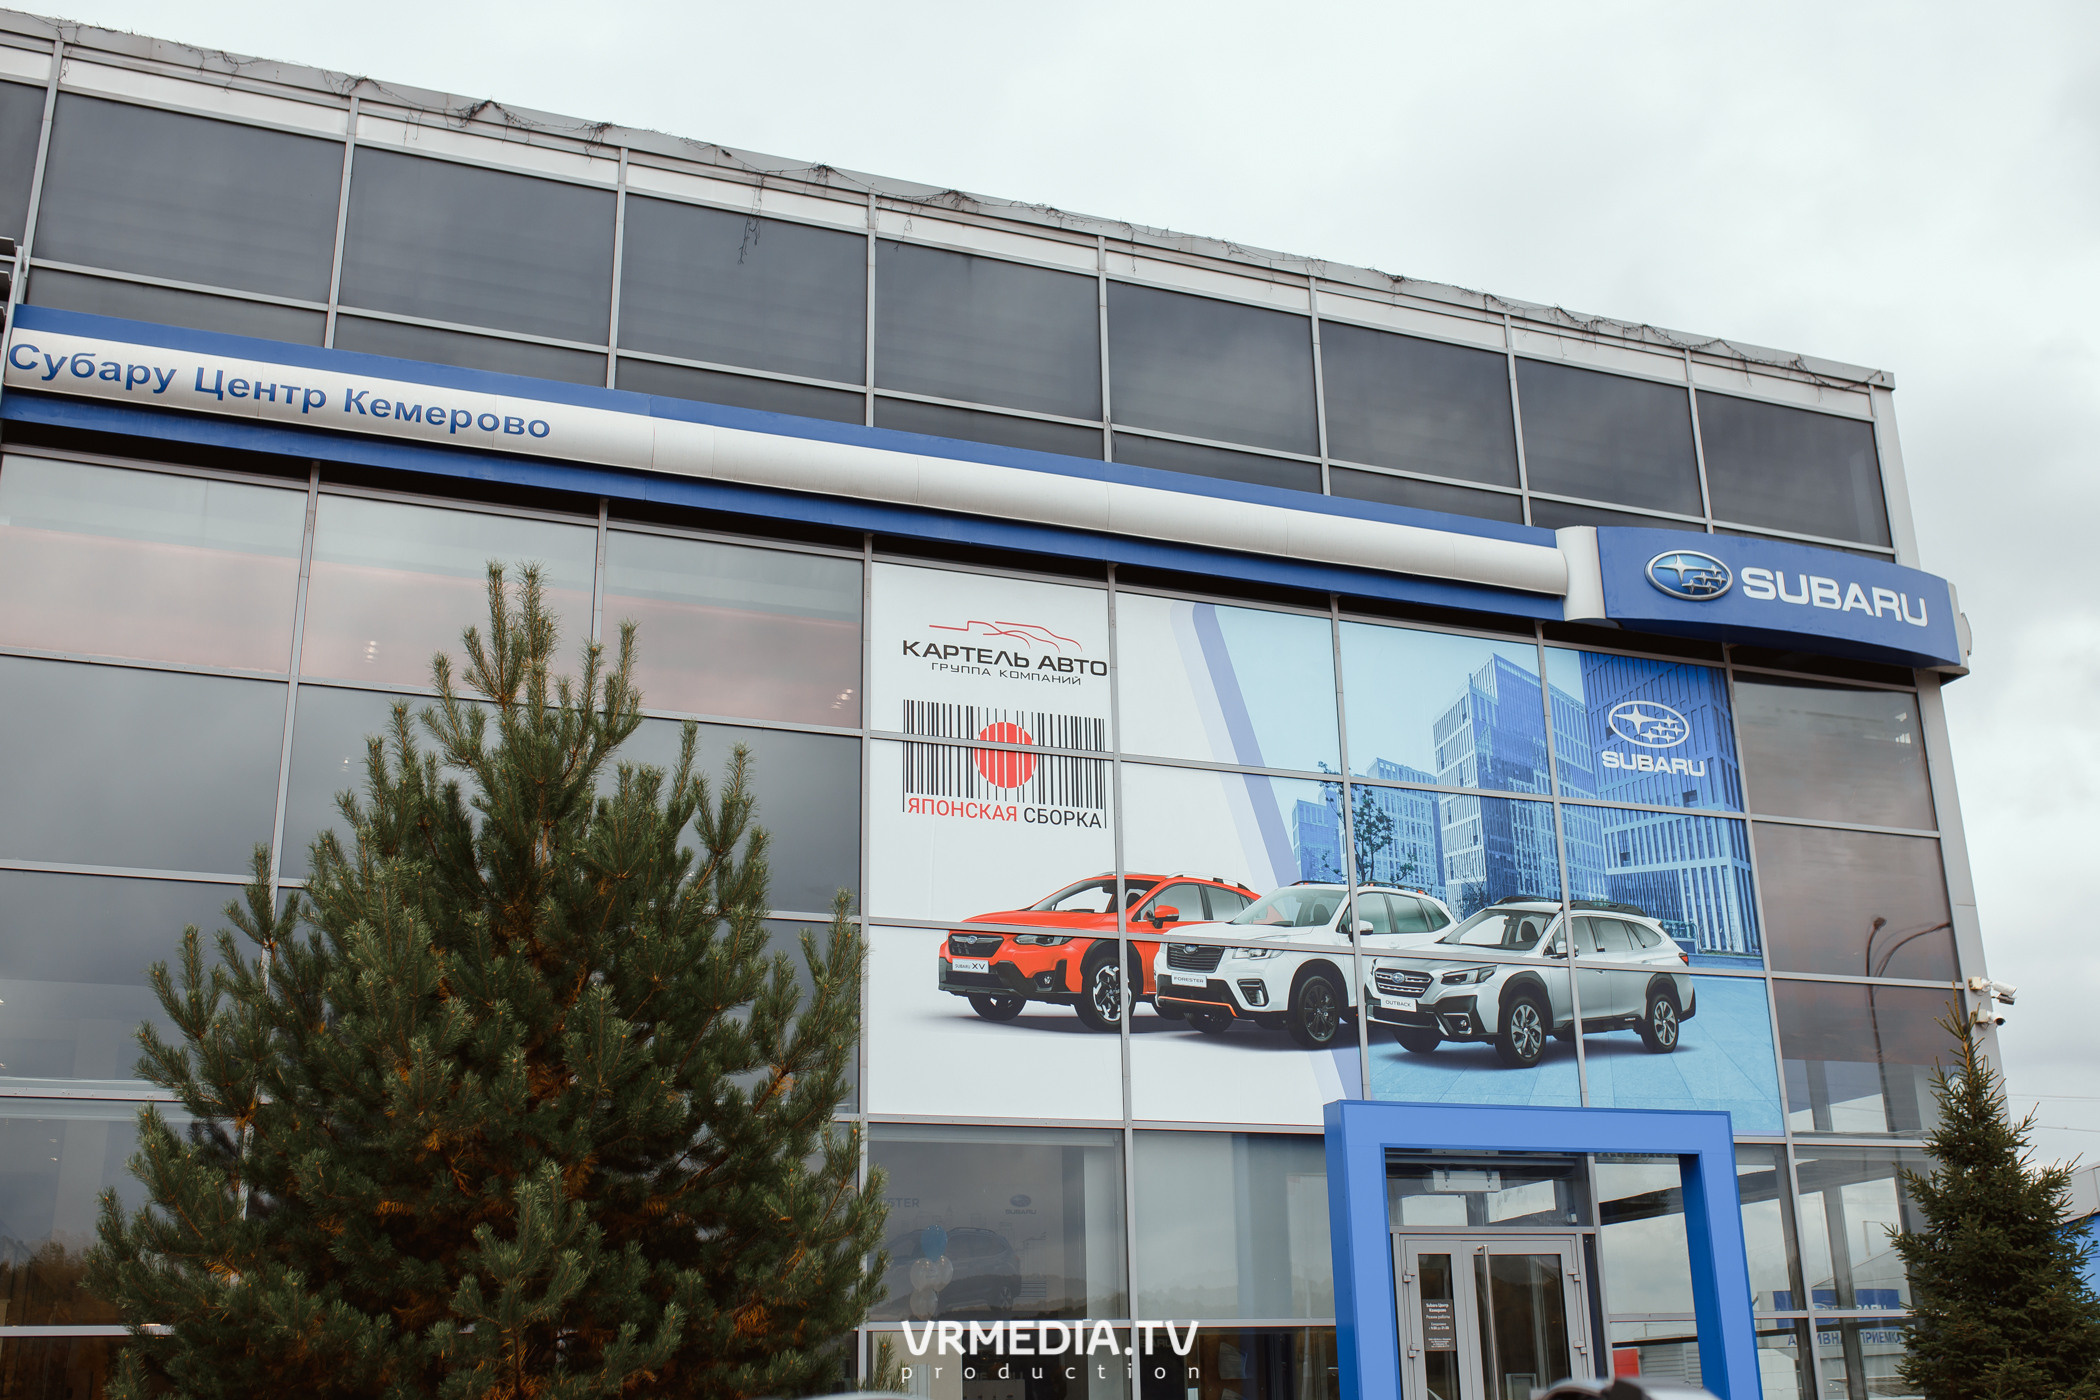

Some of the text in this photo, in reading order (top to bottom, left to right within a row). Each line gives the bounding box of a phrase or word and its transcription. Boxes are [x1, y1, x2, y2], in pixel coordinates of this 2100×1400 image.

[9, 343, 551, 439] Субару Центр Кемерово
[1740, 567, 1928, 627] SUBARU
[903, 640, 1108, 677] КАРТЕЛЬ АВТО
[931, 662, 1081, 686] ГРУППА КОМПАНИЙ
[1601, 750, 1705, 777] SUBARU
[908, 797, 1102, 829] ЯПОНСКАЯ СБОРКА
[971, 962, 985, 970] XV
[1385, 999, 1411, 1008] OUTBACK
